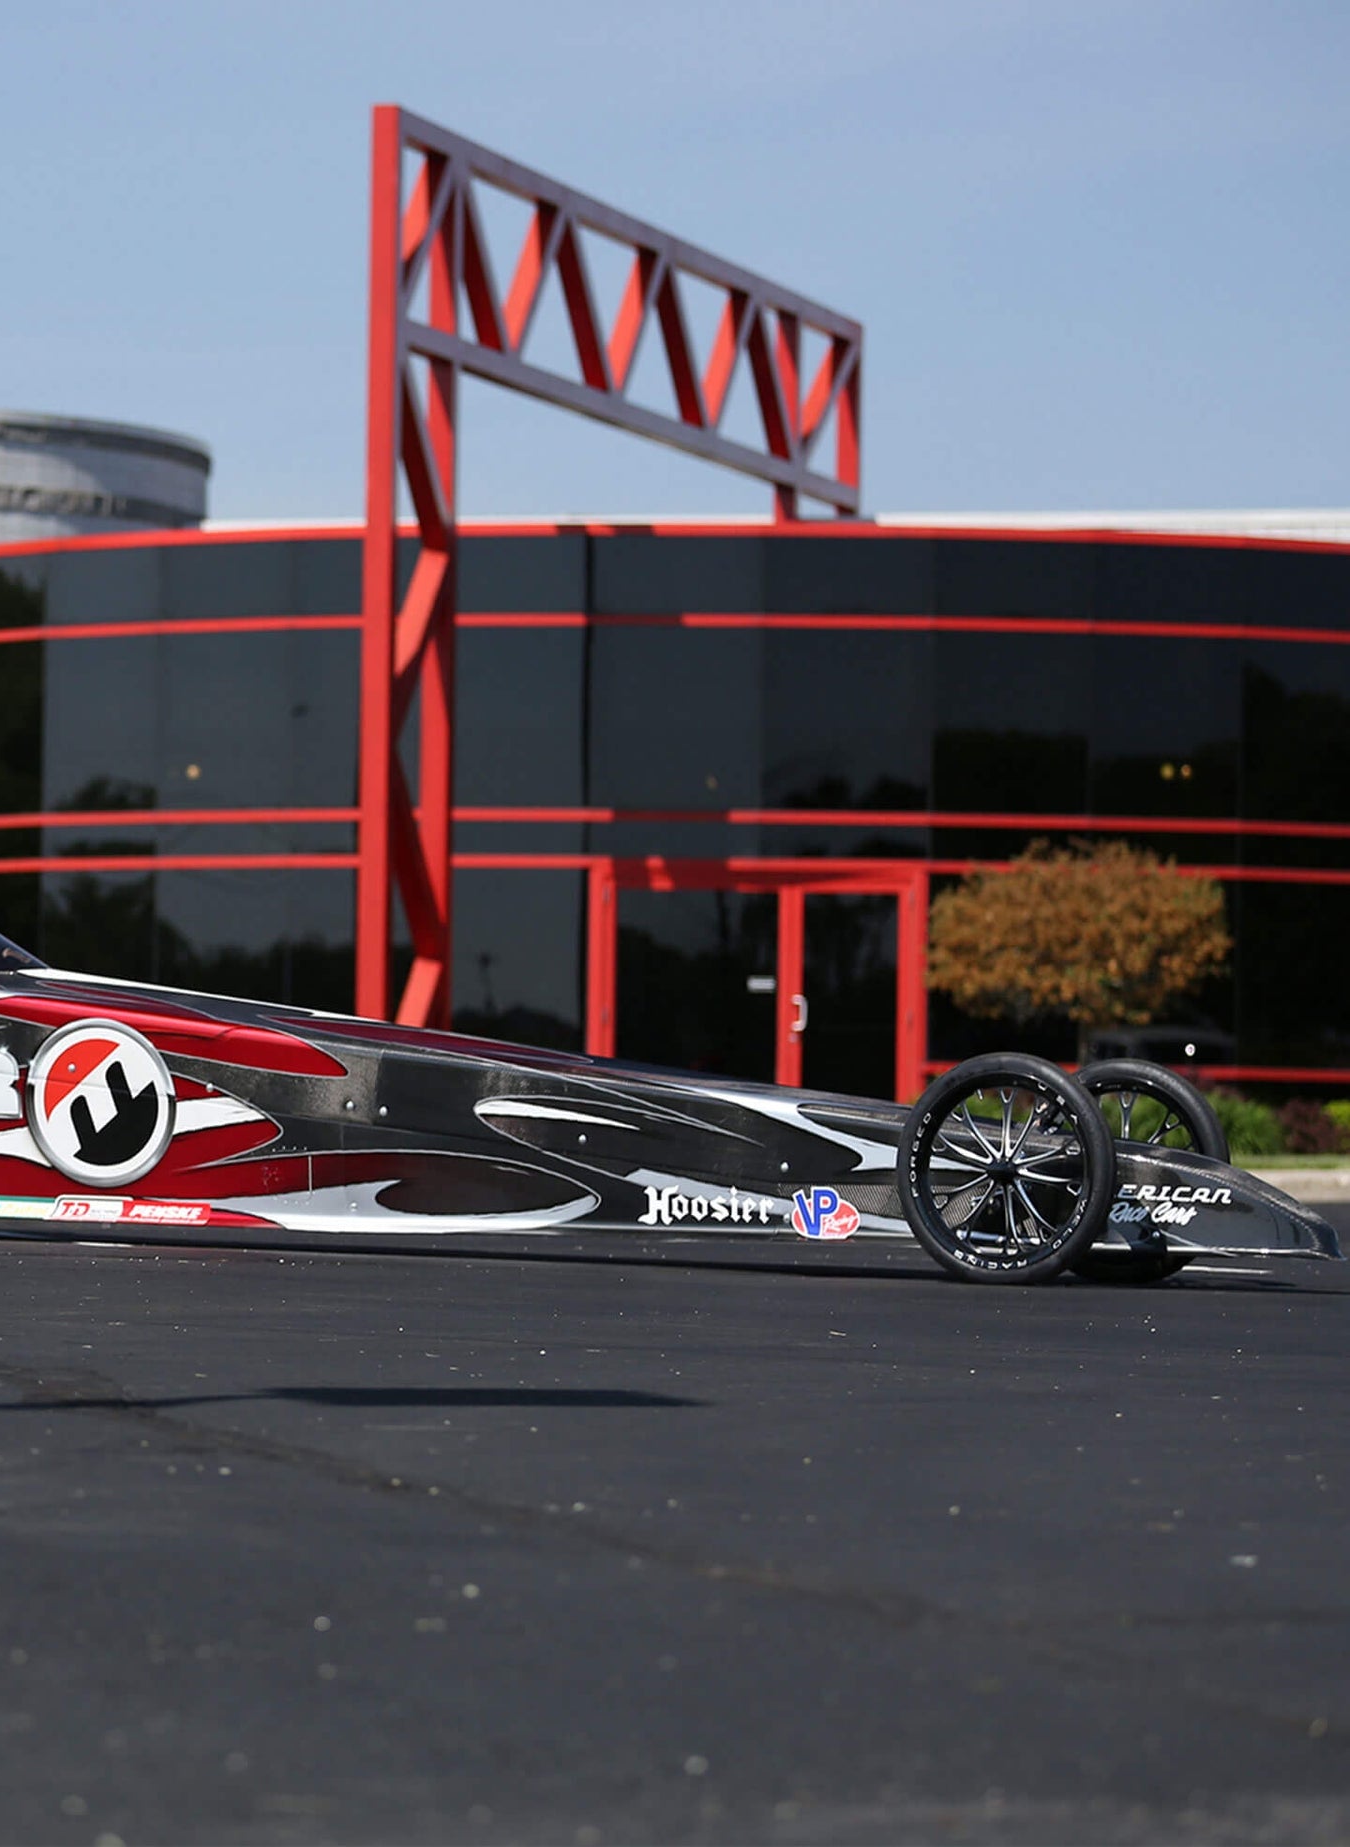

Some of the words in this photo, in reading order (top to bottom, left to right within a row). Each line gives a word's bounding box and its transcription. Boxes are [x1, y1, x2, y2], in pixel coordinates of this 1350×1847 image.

[908, 1111, 933, 1199] FORGED
[129, 1204, 203, 1220] PENSKE
[637, 1184, 775, 1226] Hoosier
[792, 1186, 839, 1239] VP
[1051, 1198, 1088, 1250] WELD
[1151, 1200, 1198, 1226] Cars
[953, 1249, 1029, 1270] RACING
